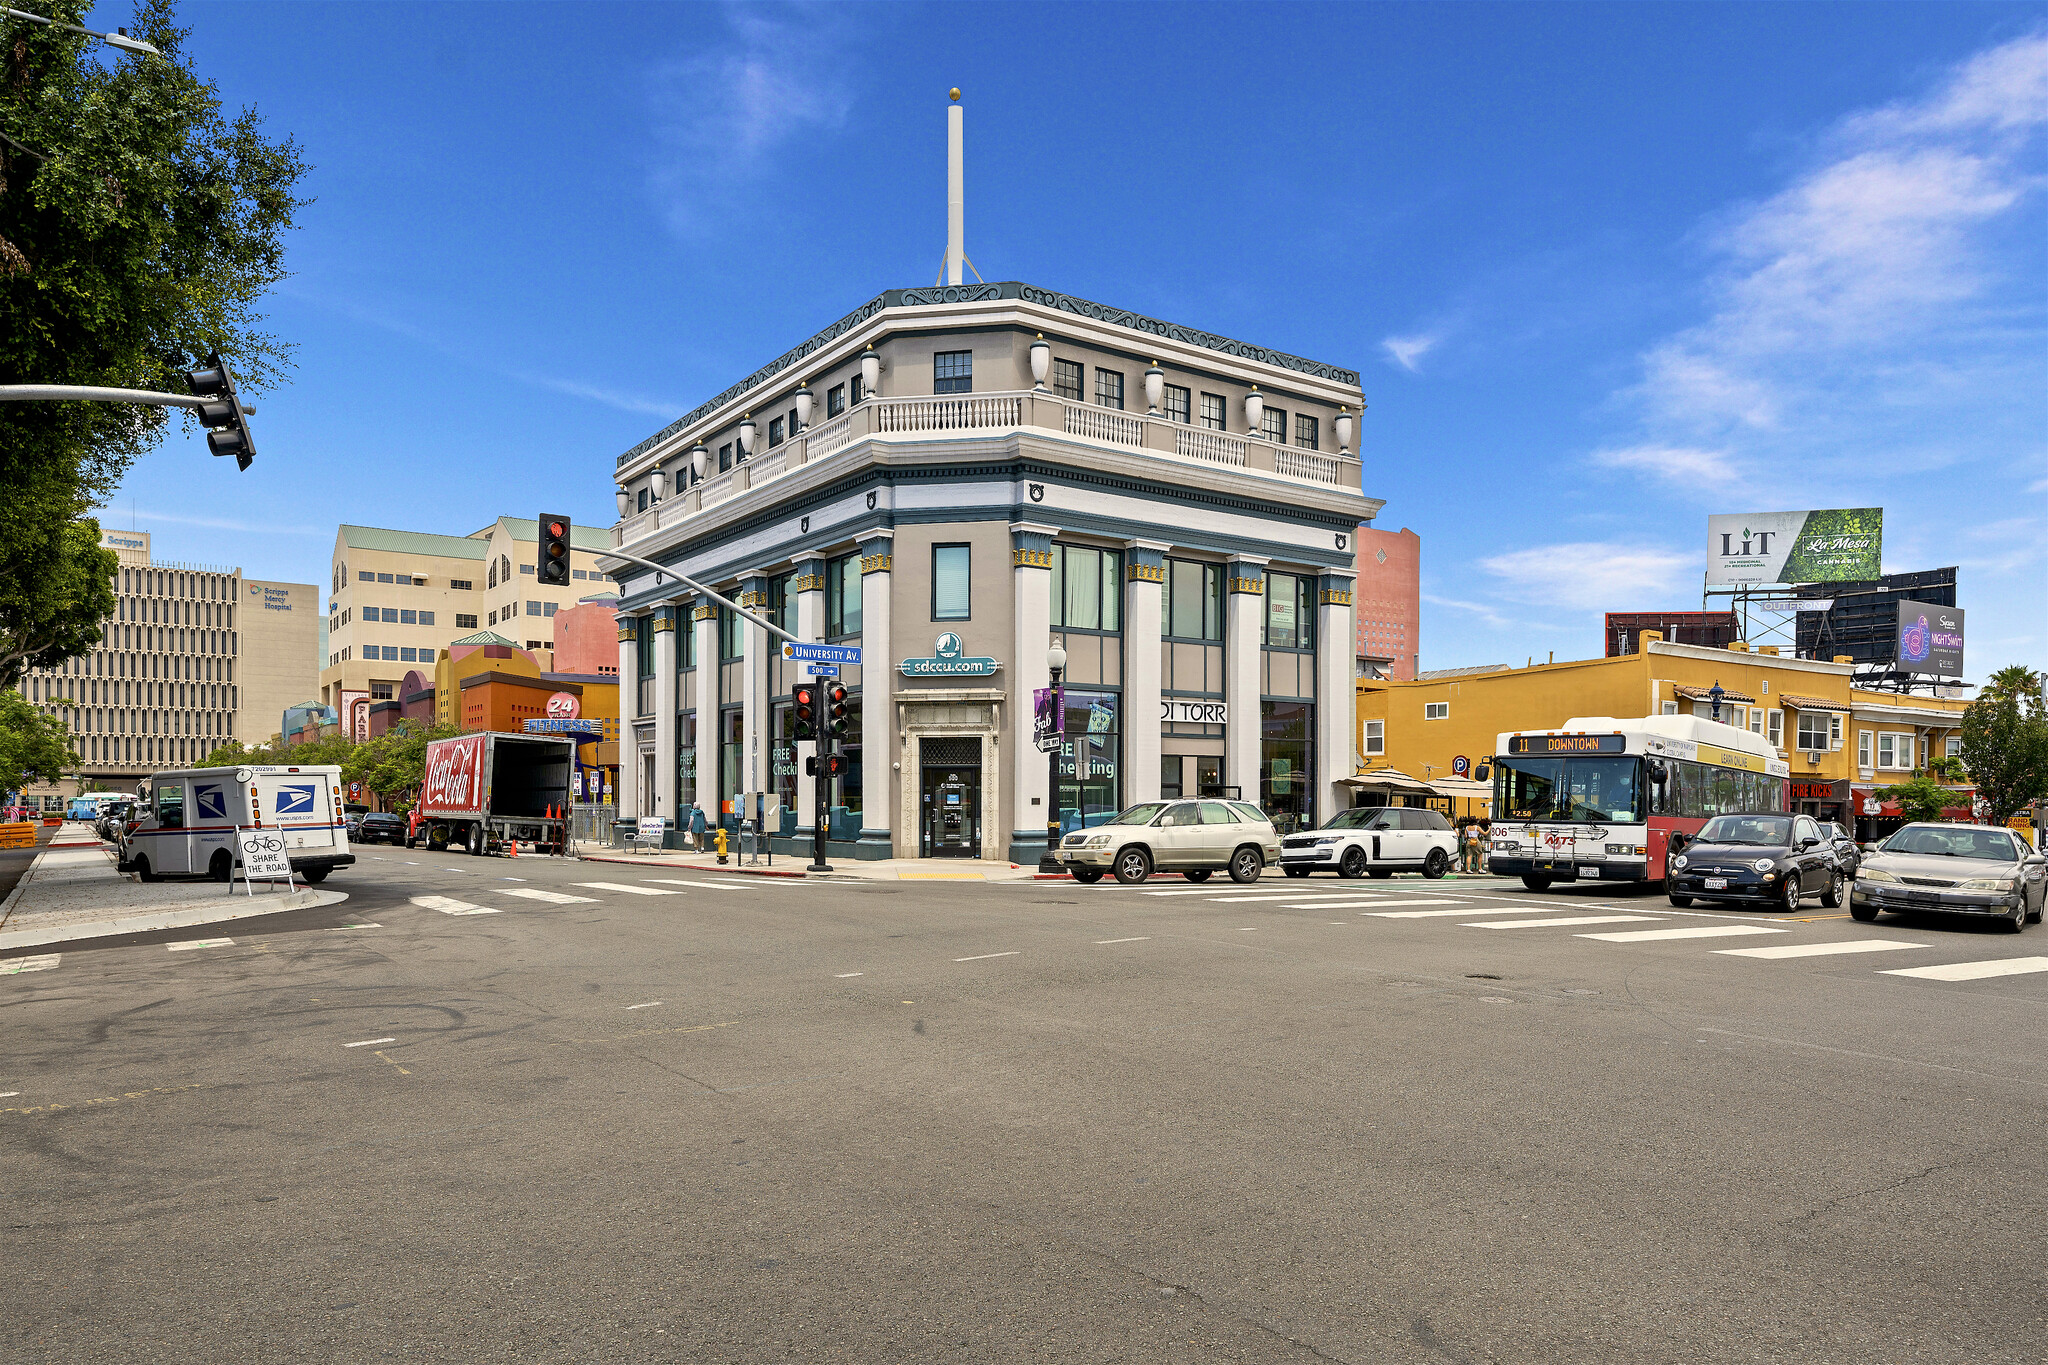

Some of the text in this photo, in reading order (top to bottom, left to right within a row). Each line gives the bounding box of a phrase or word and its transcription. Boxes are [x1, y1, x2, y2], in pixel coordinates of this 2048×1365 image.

[108, 535, 144, 548] Scripps
[1807, 537, 1870, 552] La Mesa
[264, 587, 289, 596] Scripps
[264, 595, 286, 603] Mercy
[1764, 601, 1831, 610] OUTFRONT
[264, 602, 292, 611] Hospital
[795, 646, 845, 660] UNIVERSITY
[914, 660, 983, 673] sdccu.com
[549, 699, 574, 713] 24
[1180, 703, 1226, 722] TORR
[528, 719, 592, 732] FITNESS
[1034, 712, 1052, 732] Fab
[1043, 738, 1052, 748] ONE
[1519, 737, 1599, 752] 11 DOWNTOWN
[680, 755, 692, 765] FREE
[773, 748, 790, 761] FREE
[1721, 753, 1748, 768] LEARN ONLINE
[1457, 761, 1464, 770] P
[1792, 783, 1833, 798] FIRE KICKS
[1545, 836, 1577, 845] MTS
[252, 853, 279, 863] SHARE
[247, 863, 288, 873] THE ROAD
